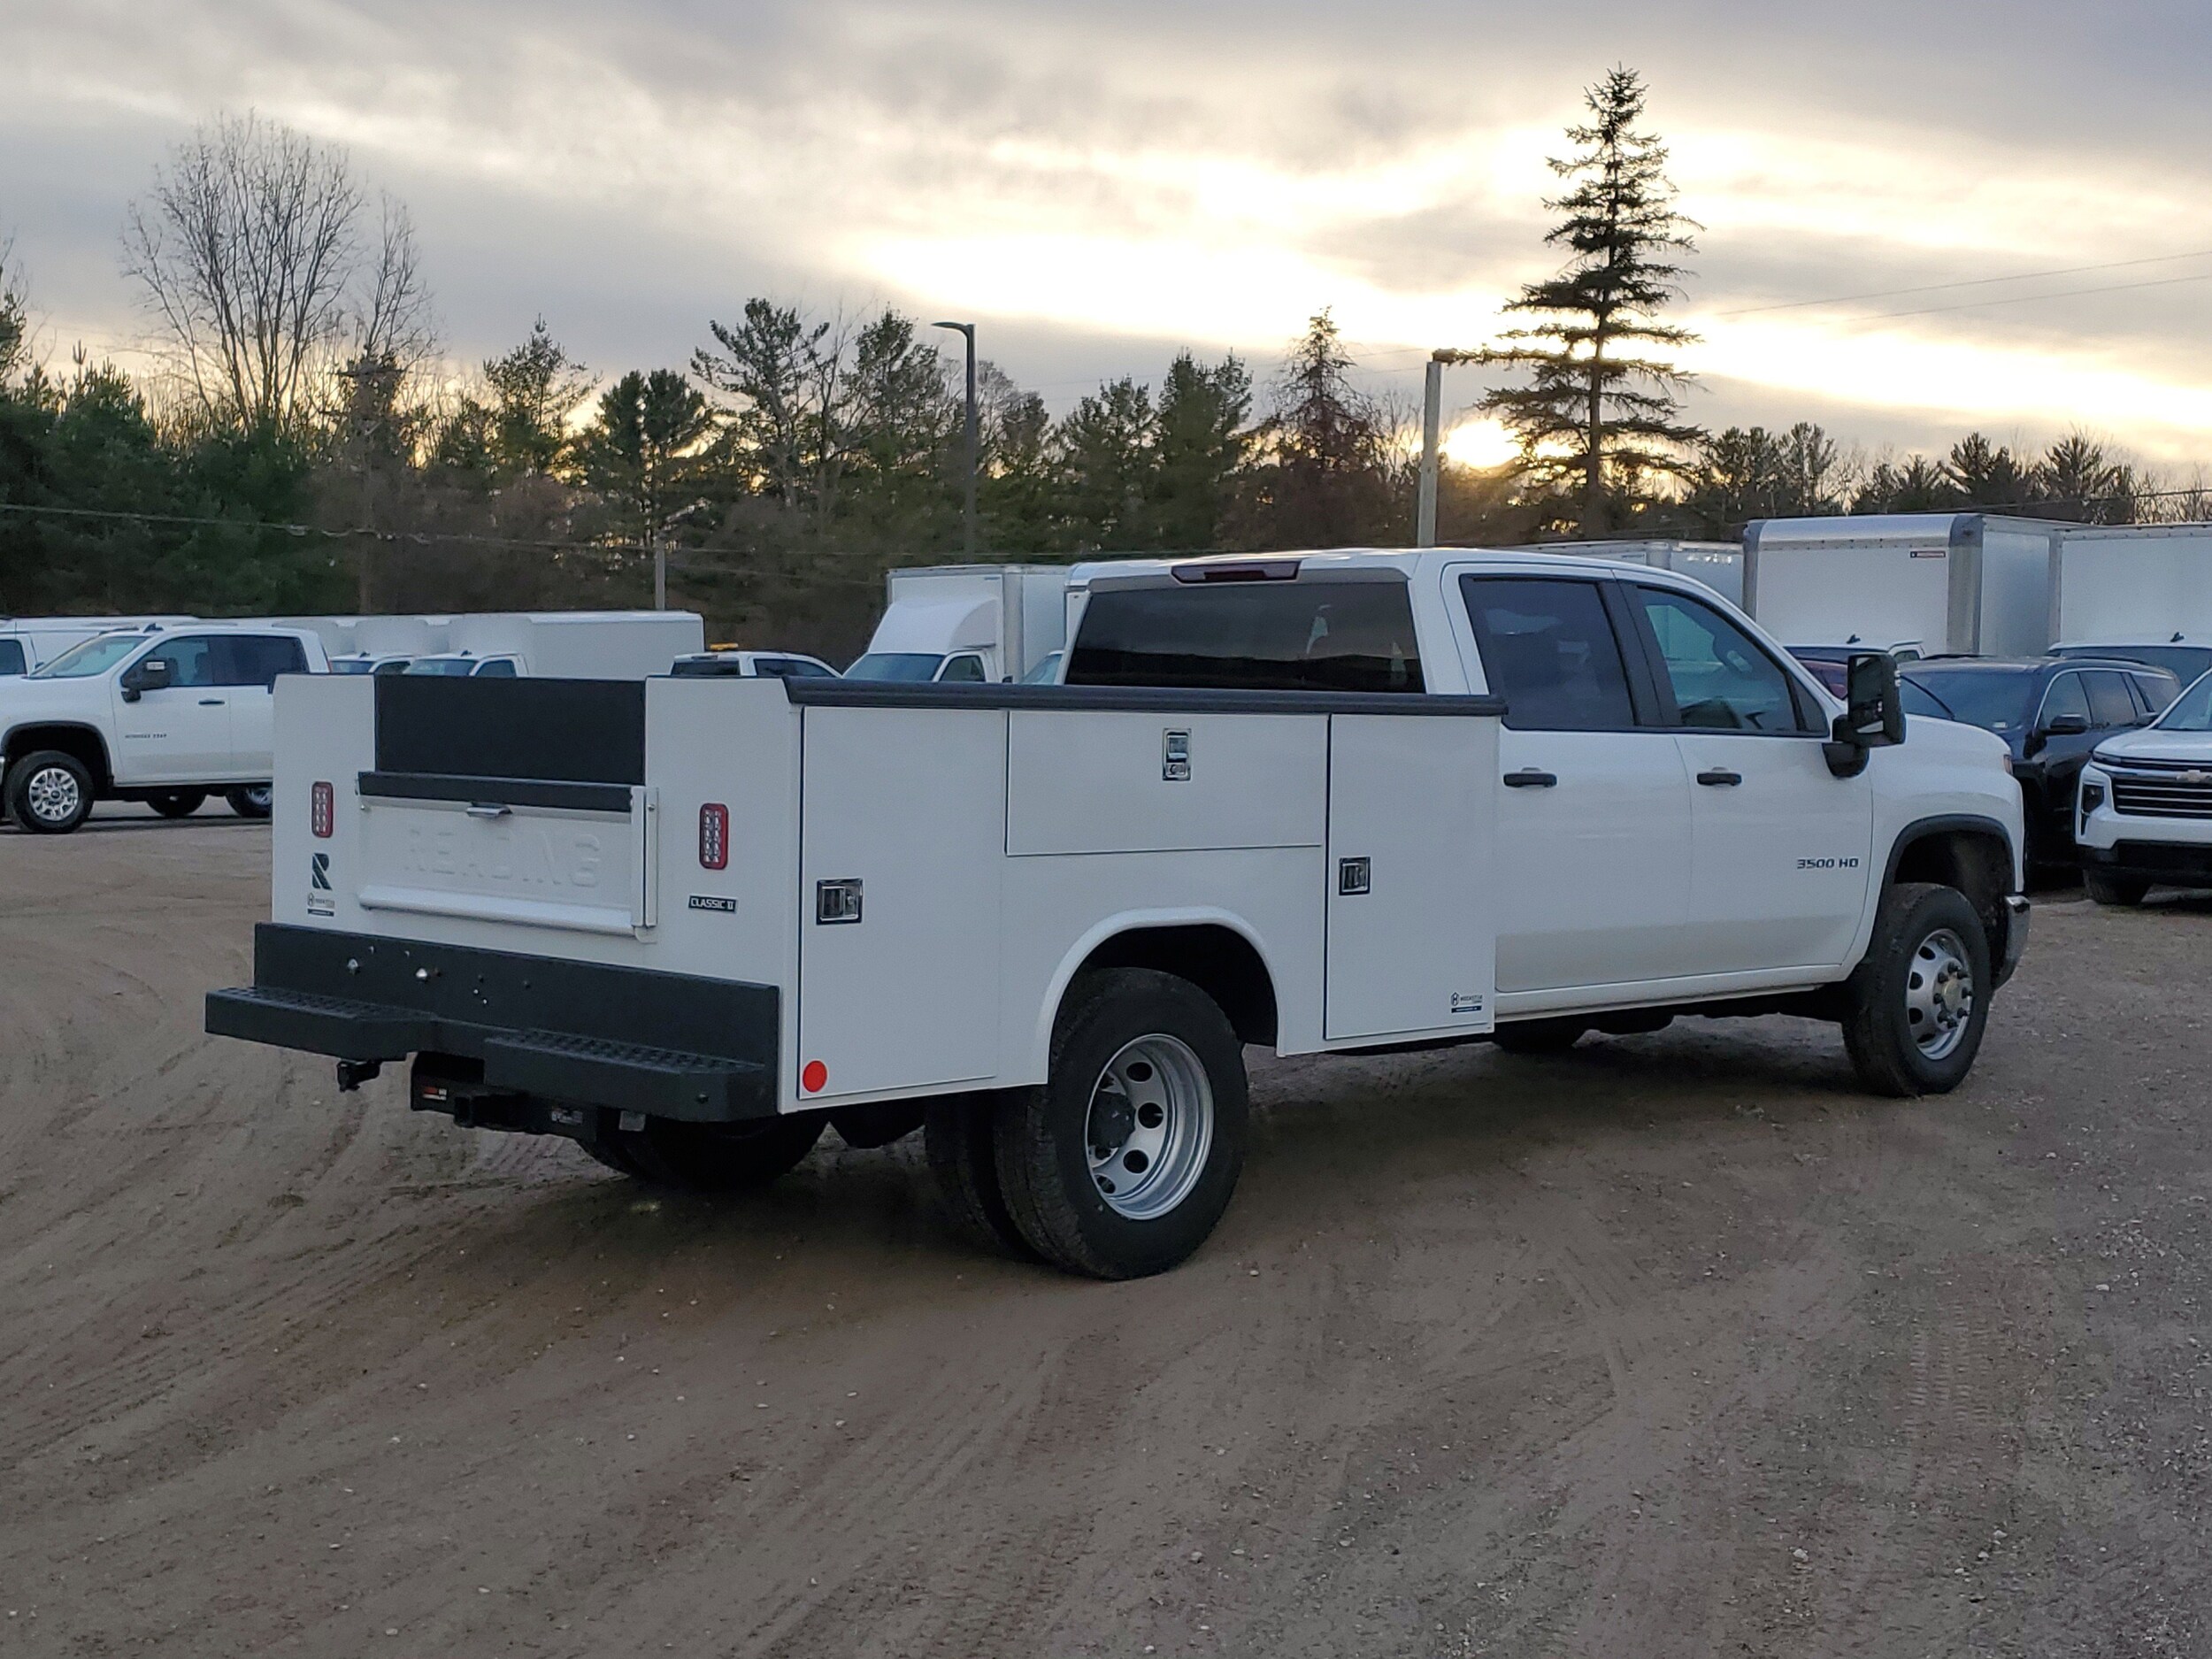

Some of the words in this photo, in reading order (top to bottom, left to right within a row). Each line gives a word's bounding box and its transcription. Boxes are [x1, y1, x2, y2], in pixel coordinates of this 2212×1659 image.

[1797, 857, 1835, 869] 3500
[1839, 857, 1859, 869] HD
[690, 897, 726, 909] CLASSIC
